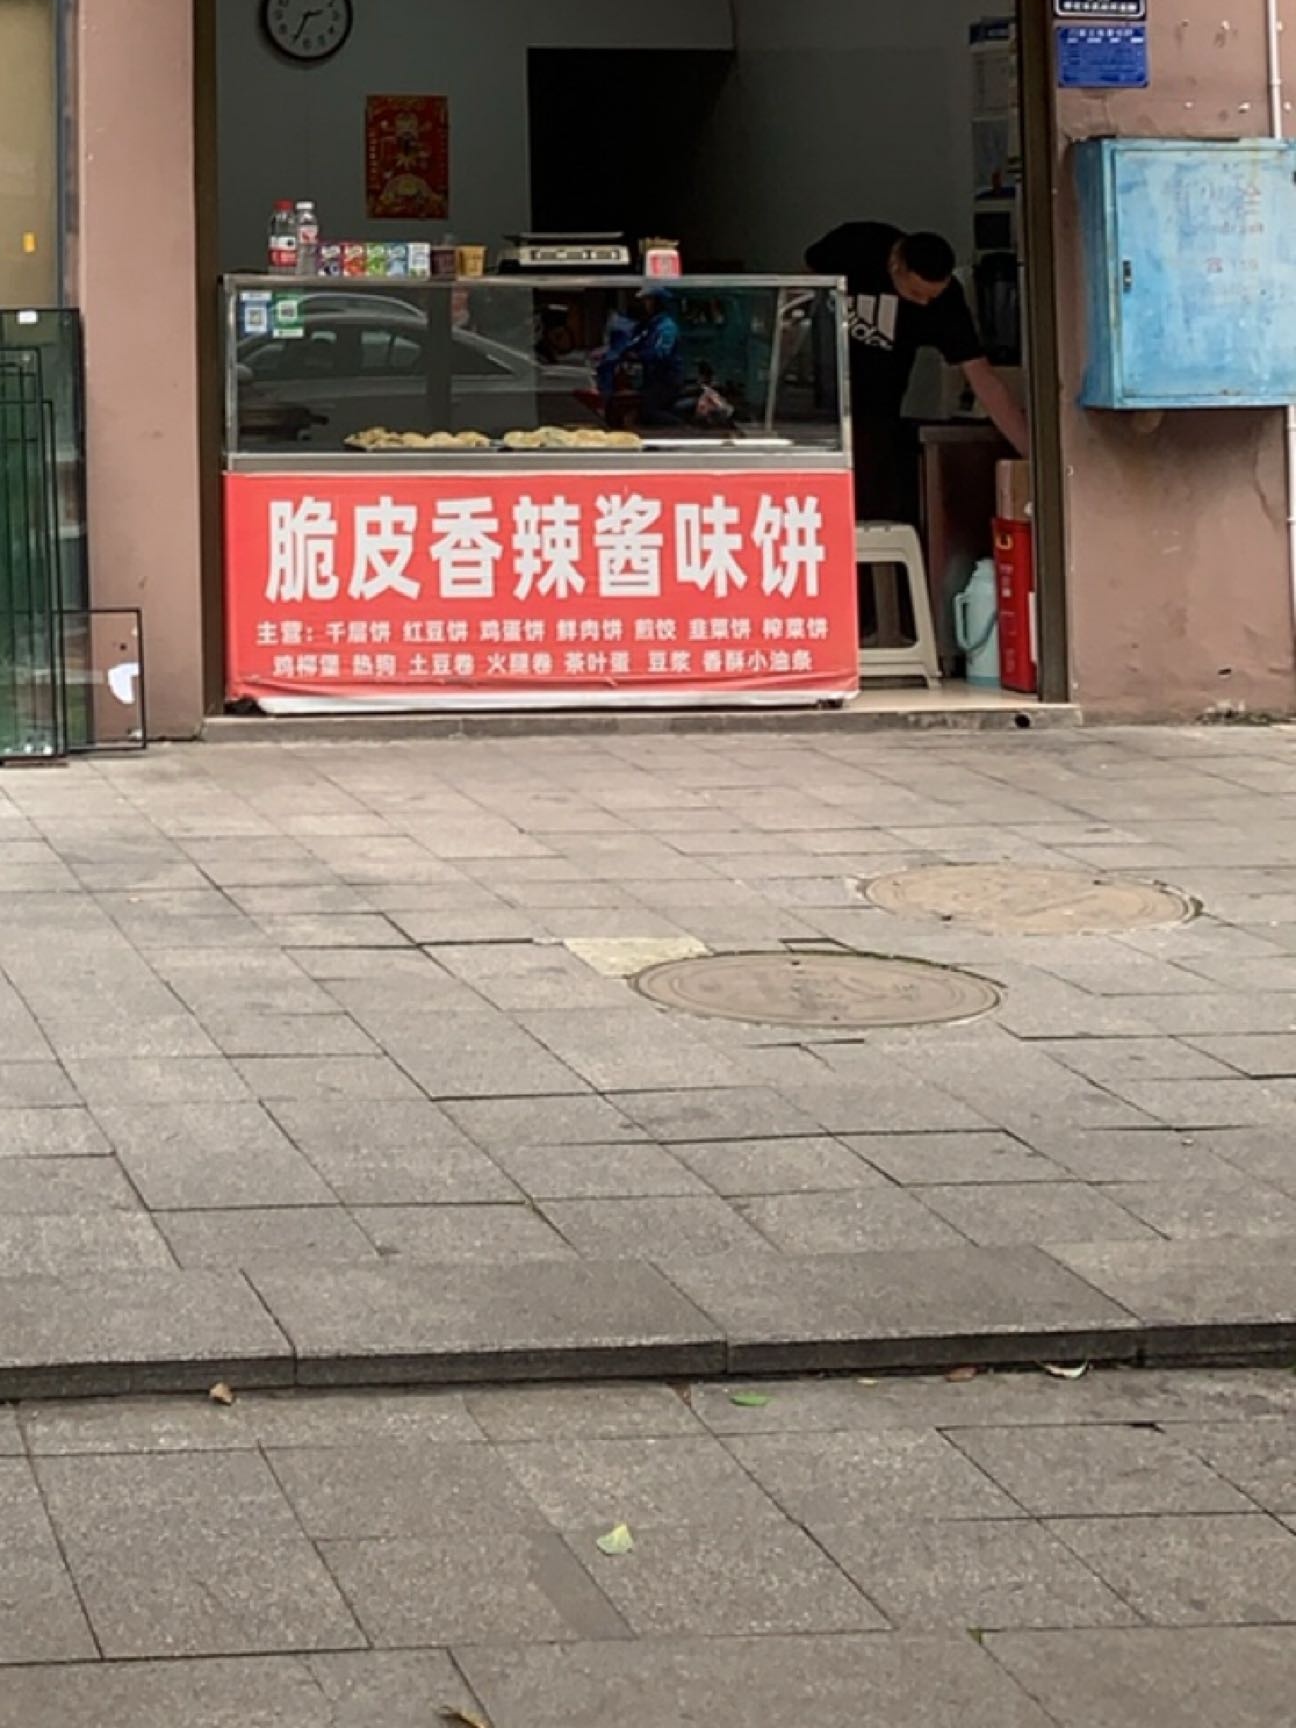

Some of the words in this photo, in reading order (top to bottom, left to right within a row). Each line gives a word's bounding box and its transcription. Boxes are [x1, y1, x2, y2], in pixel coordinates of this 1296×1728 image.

[265, 493, 825, 602] 脆皮香辣酱味饼
